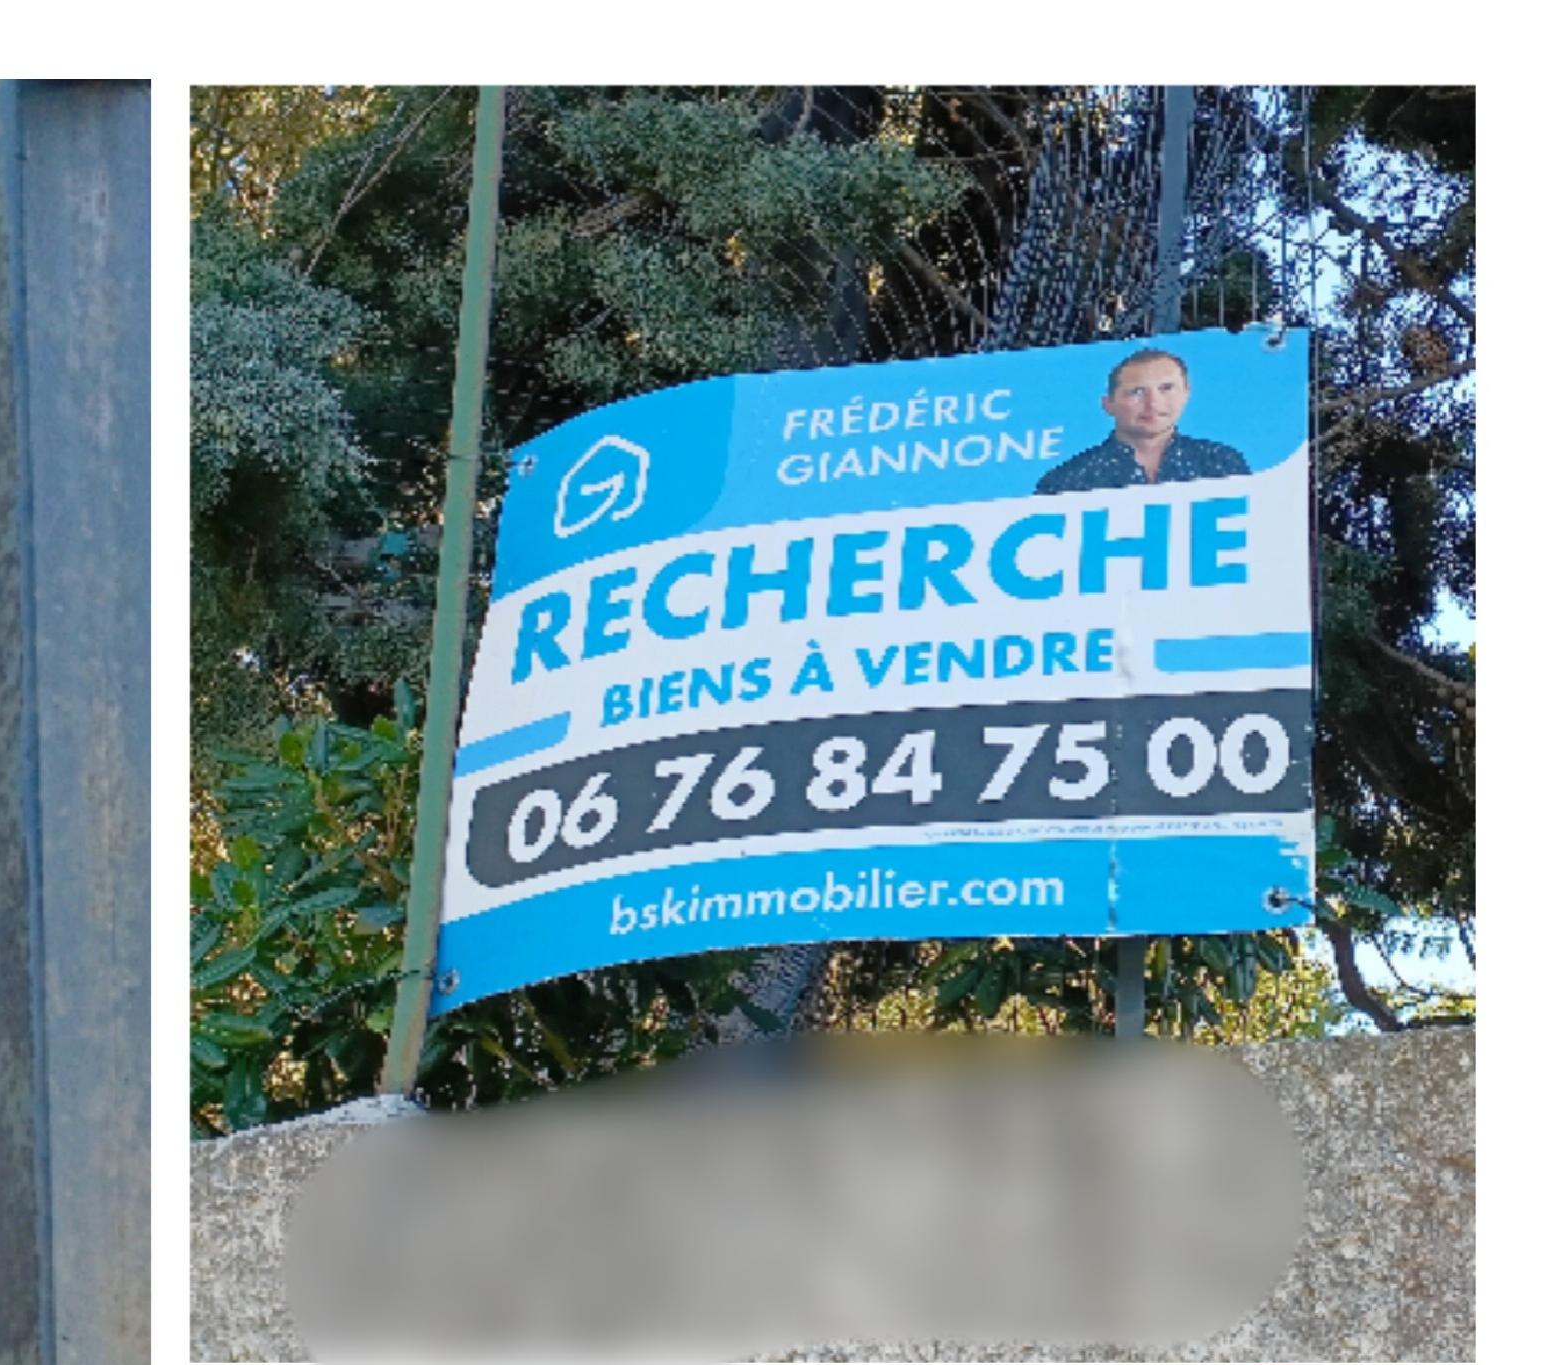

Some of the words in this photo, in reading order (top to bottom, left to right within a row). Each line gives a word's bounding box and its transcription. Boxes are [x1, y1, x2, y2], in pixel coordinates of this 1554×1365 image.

[783, 388, 1012, 439] FRÉDÉRIC
[776, 426, 1064, 486] GIANNONE
[511, 495, 1250, 685] RECHERCHE
[601, 656, 771, 728] BIENS
[789, 640, 834, 695] À
[855, 629, 1115, 686] VENDRE
[506, 772, 619, 863] 06
[647, 747, 775, 834] 76
[806, 731, 942, 810] 84
[980, 722, 1108, 801] 75
[1146, 713, 1290, 797] 00
[609, 867, 1064, 936] bskimmobilier.com
